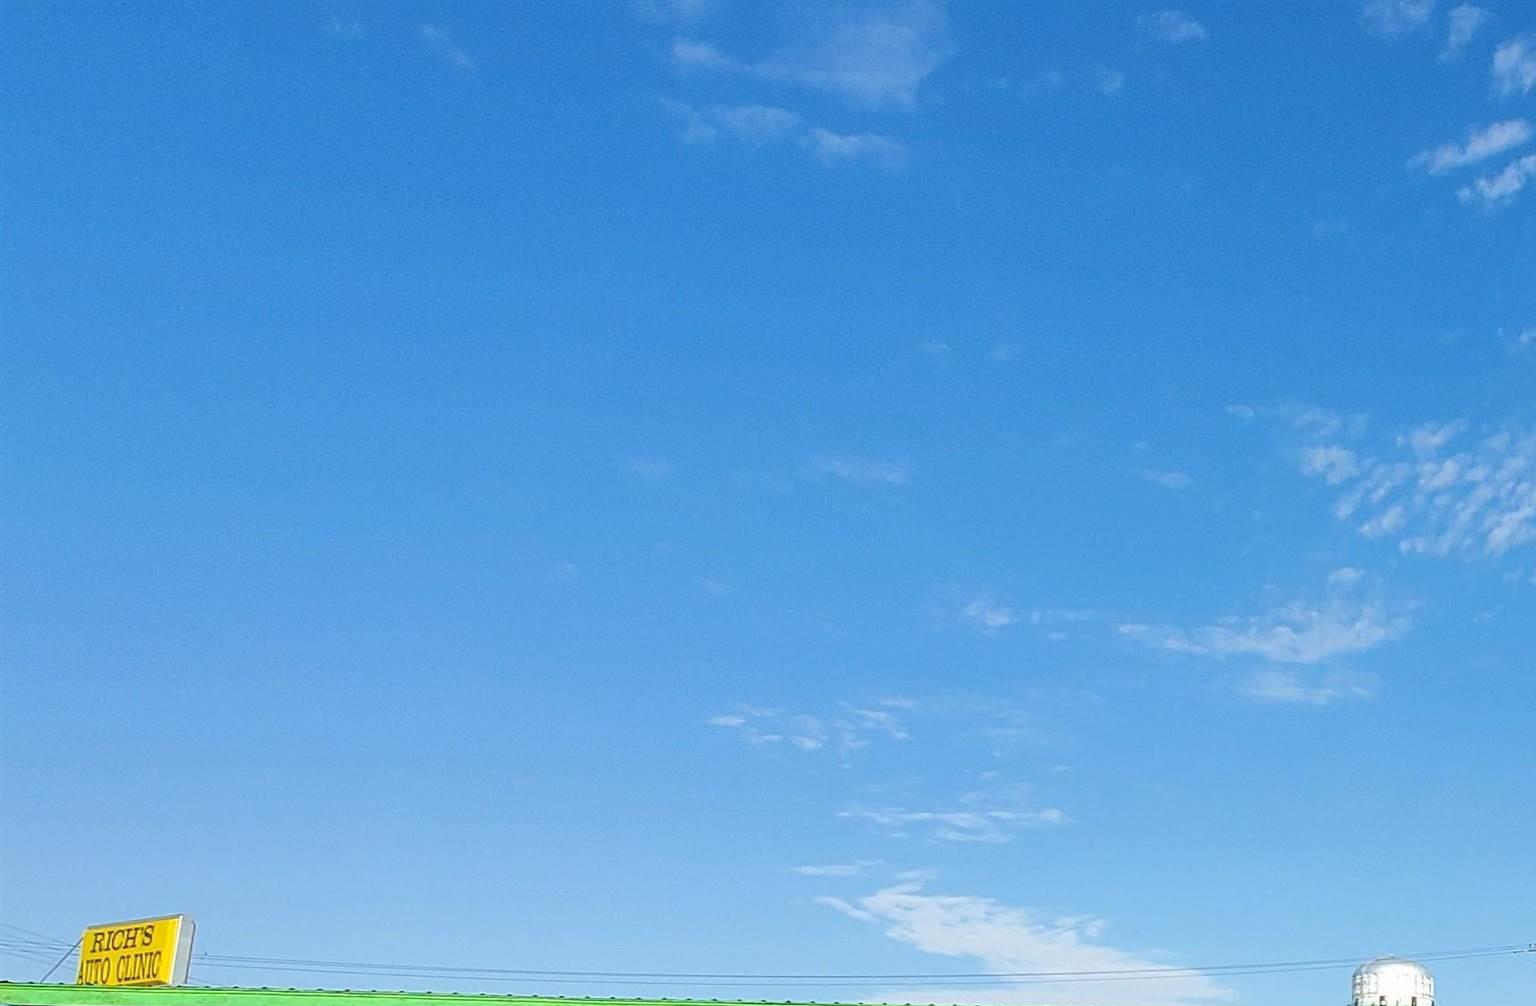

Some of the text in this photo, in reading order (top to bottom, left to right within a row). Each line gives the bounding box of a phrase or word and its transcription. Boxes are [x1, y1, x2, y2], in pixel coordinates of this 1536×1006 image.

[90, 925, 154, 953] RICH'S
[77, 950, 161, 985] AUTO CLINIC
